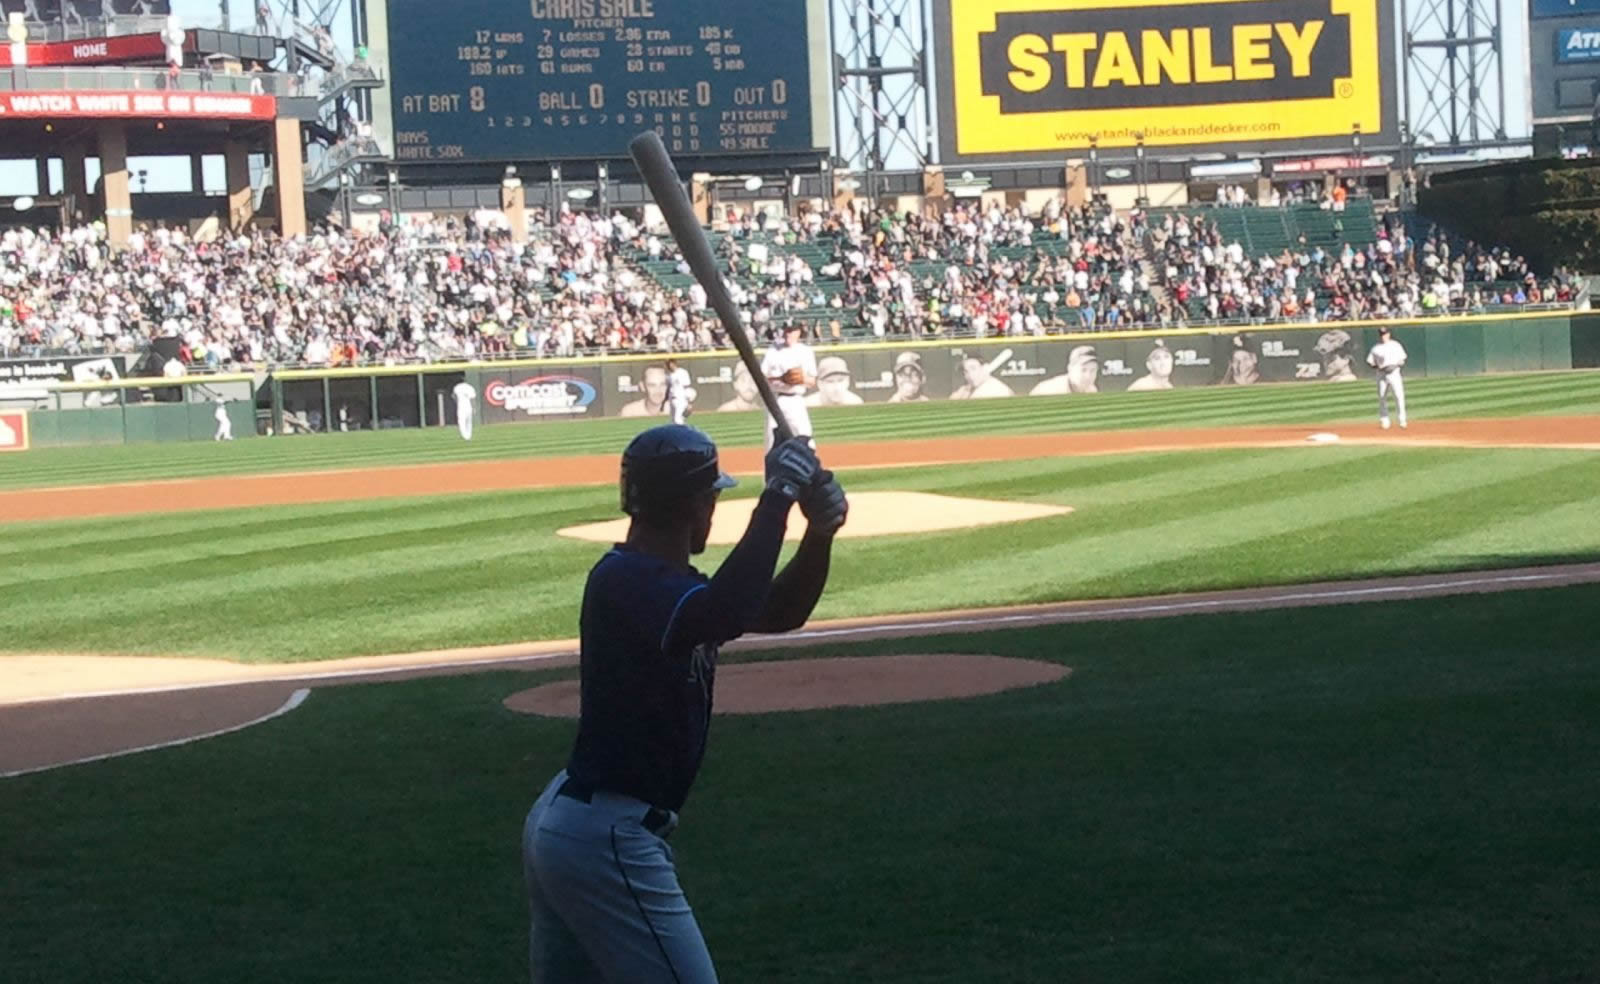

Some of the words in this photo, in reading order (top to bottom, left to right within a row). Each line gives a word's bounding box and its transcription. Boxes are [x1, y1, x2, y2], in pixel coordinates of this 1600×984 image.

[531, 0, 595, 18] CHRIS
[601, 0, 654, 17] SALE
[574, 18, 624, 28] PITCHER
[476, 30, 490, 43] 17
[494, 32, 524, 44] WINS
[544, 29, 552, 42] 7
[560, 32, 605, 42] LOSSES
[646, 30, 670, 40] ERA
[724, 28, 733, 38] K
[73, 43, 107, 58] HOME
[560, 48, 600, 58] GAMES
[648, 46, 694, 56] STARTS
[1007, 21, 1325, 92] STANLEY
[496, 64, 524, 74] HITS
[561, 64, 592, 74] RUNS
[713, 57, 722, 70] 5
[538, 92, 582, 110] BALL
[590, 84, 604, 108] 0
[626, 88, 690, 108] STRIKE
[696, 80, 710, 106] 0
[734, 87, 764, 105] OUT
[772, 78, 786, 104] 0
[10, 96, 71, 112] WATCH
[76, 96, 129, 112] WHITE
[403, 96, 424, 112] AT
[429, 94, 460, 112] BAT
[470, 85, 485, 112] 8
[488, 116, 495, 127] 1
[504, 116, 514, 127] 2
[522, 116, 531, 126] 3
[543, 116, 553, 126] 4
[560, 115, 569, 126] 5
[578, 114, 588, 125] 6
[616, 113, 625, 124] 8
[634, 113, 643, 124] 9
[655, 112, 664, 123] R
[672, 112, 681, 122] H
[689, 112, 697, 122] E
[722, 110, 788, 121] PITCHERS
[720, 122, 735, 135] 55
[738, 122, 776, 135] MOORE
[1055, 122, 1281, 142] wwwstanleyblackanddecker.com
[397, 131, 428, 144] RAYS
[740, 136, 768, 149] SALE
[397, 145, 433, 158] WHITE
[438, 144, 463, 158] SOX
[492, 382, 566, 400] comcast
